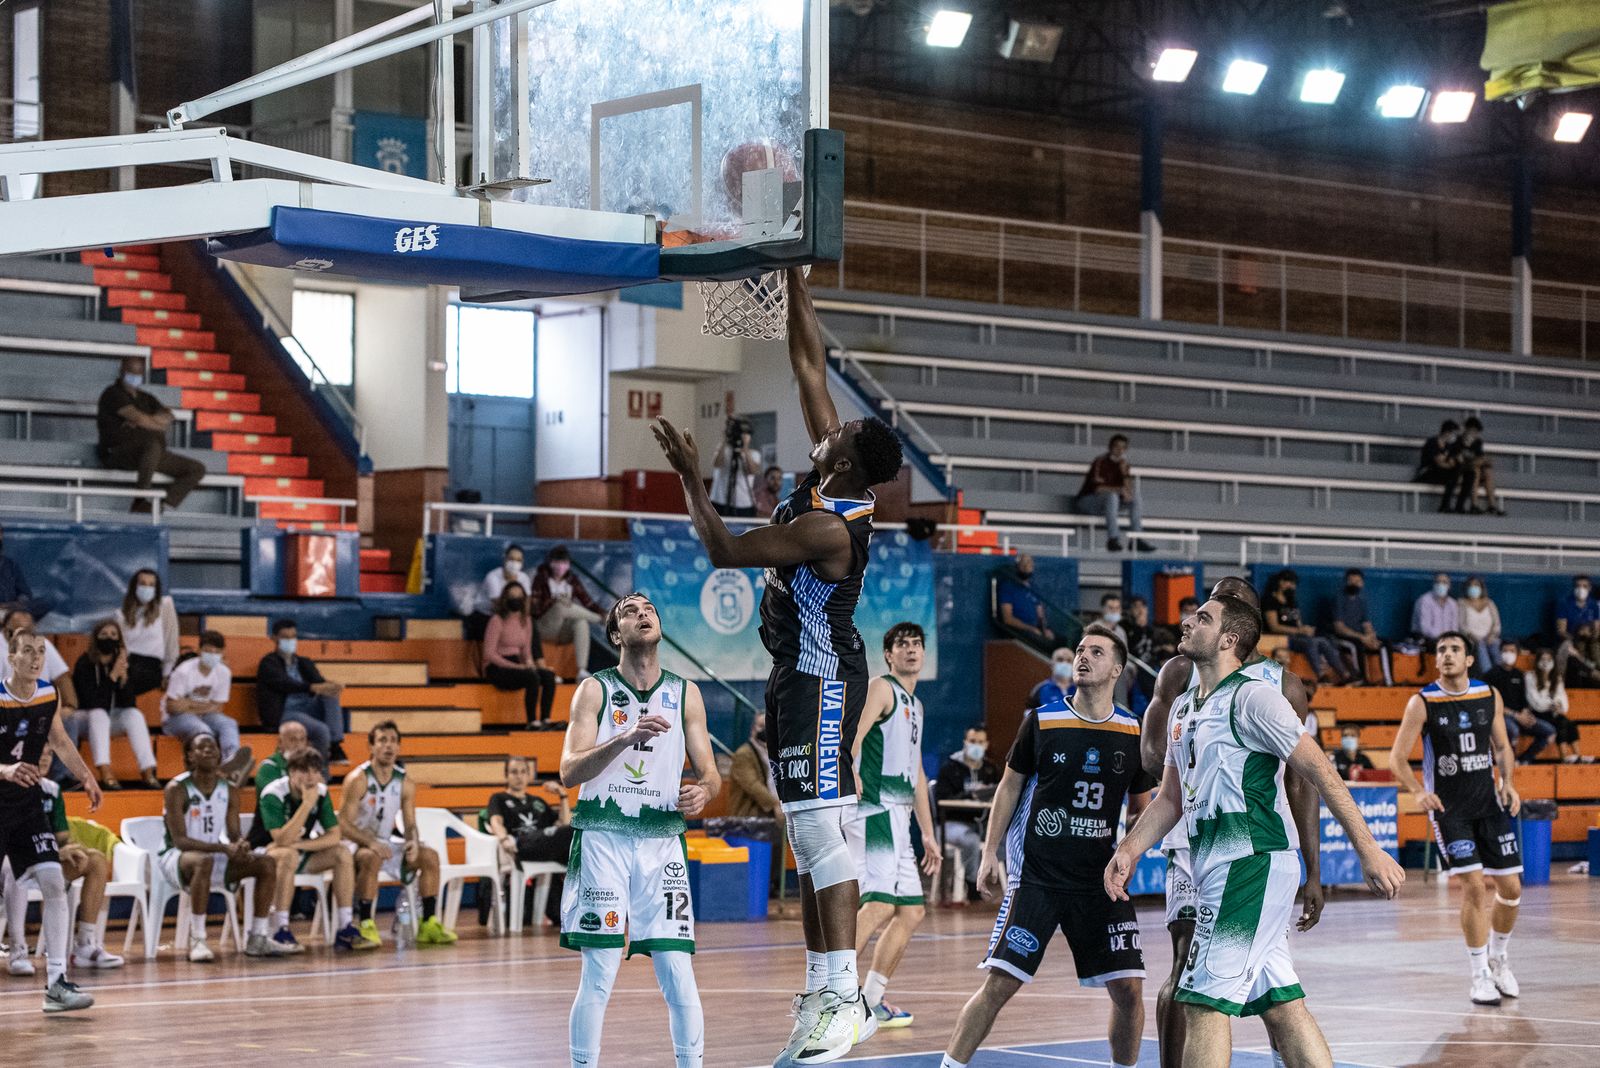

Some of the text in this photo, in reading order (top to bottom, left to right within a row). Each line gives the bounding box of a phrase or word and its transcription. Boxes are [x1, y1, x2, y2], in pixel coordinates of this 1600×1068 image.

[393, 224, 440, 253] GES
[10, 740, 25, 761] 4
[1459, 732, 1477, 753] 10
[820, 719, 842, 793] HUELVA
[788, 759, 810, 780] ORO
[607, 783, 661, 797] Extremadura
[1072, 780, 1105, 810] 33
[204, 816, 214, 834] 15
[1070, 816, 1107, 829] HUELVA
[1070, 826, 1112, 838] TE SALUDA
[1325, 820, 1344, 837] de
[664, 892, 689, 921] 12
[1011, 929, 1034, 948] Ford
[1110, 933, 1129, 952] DE
